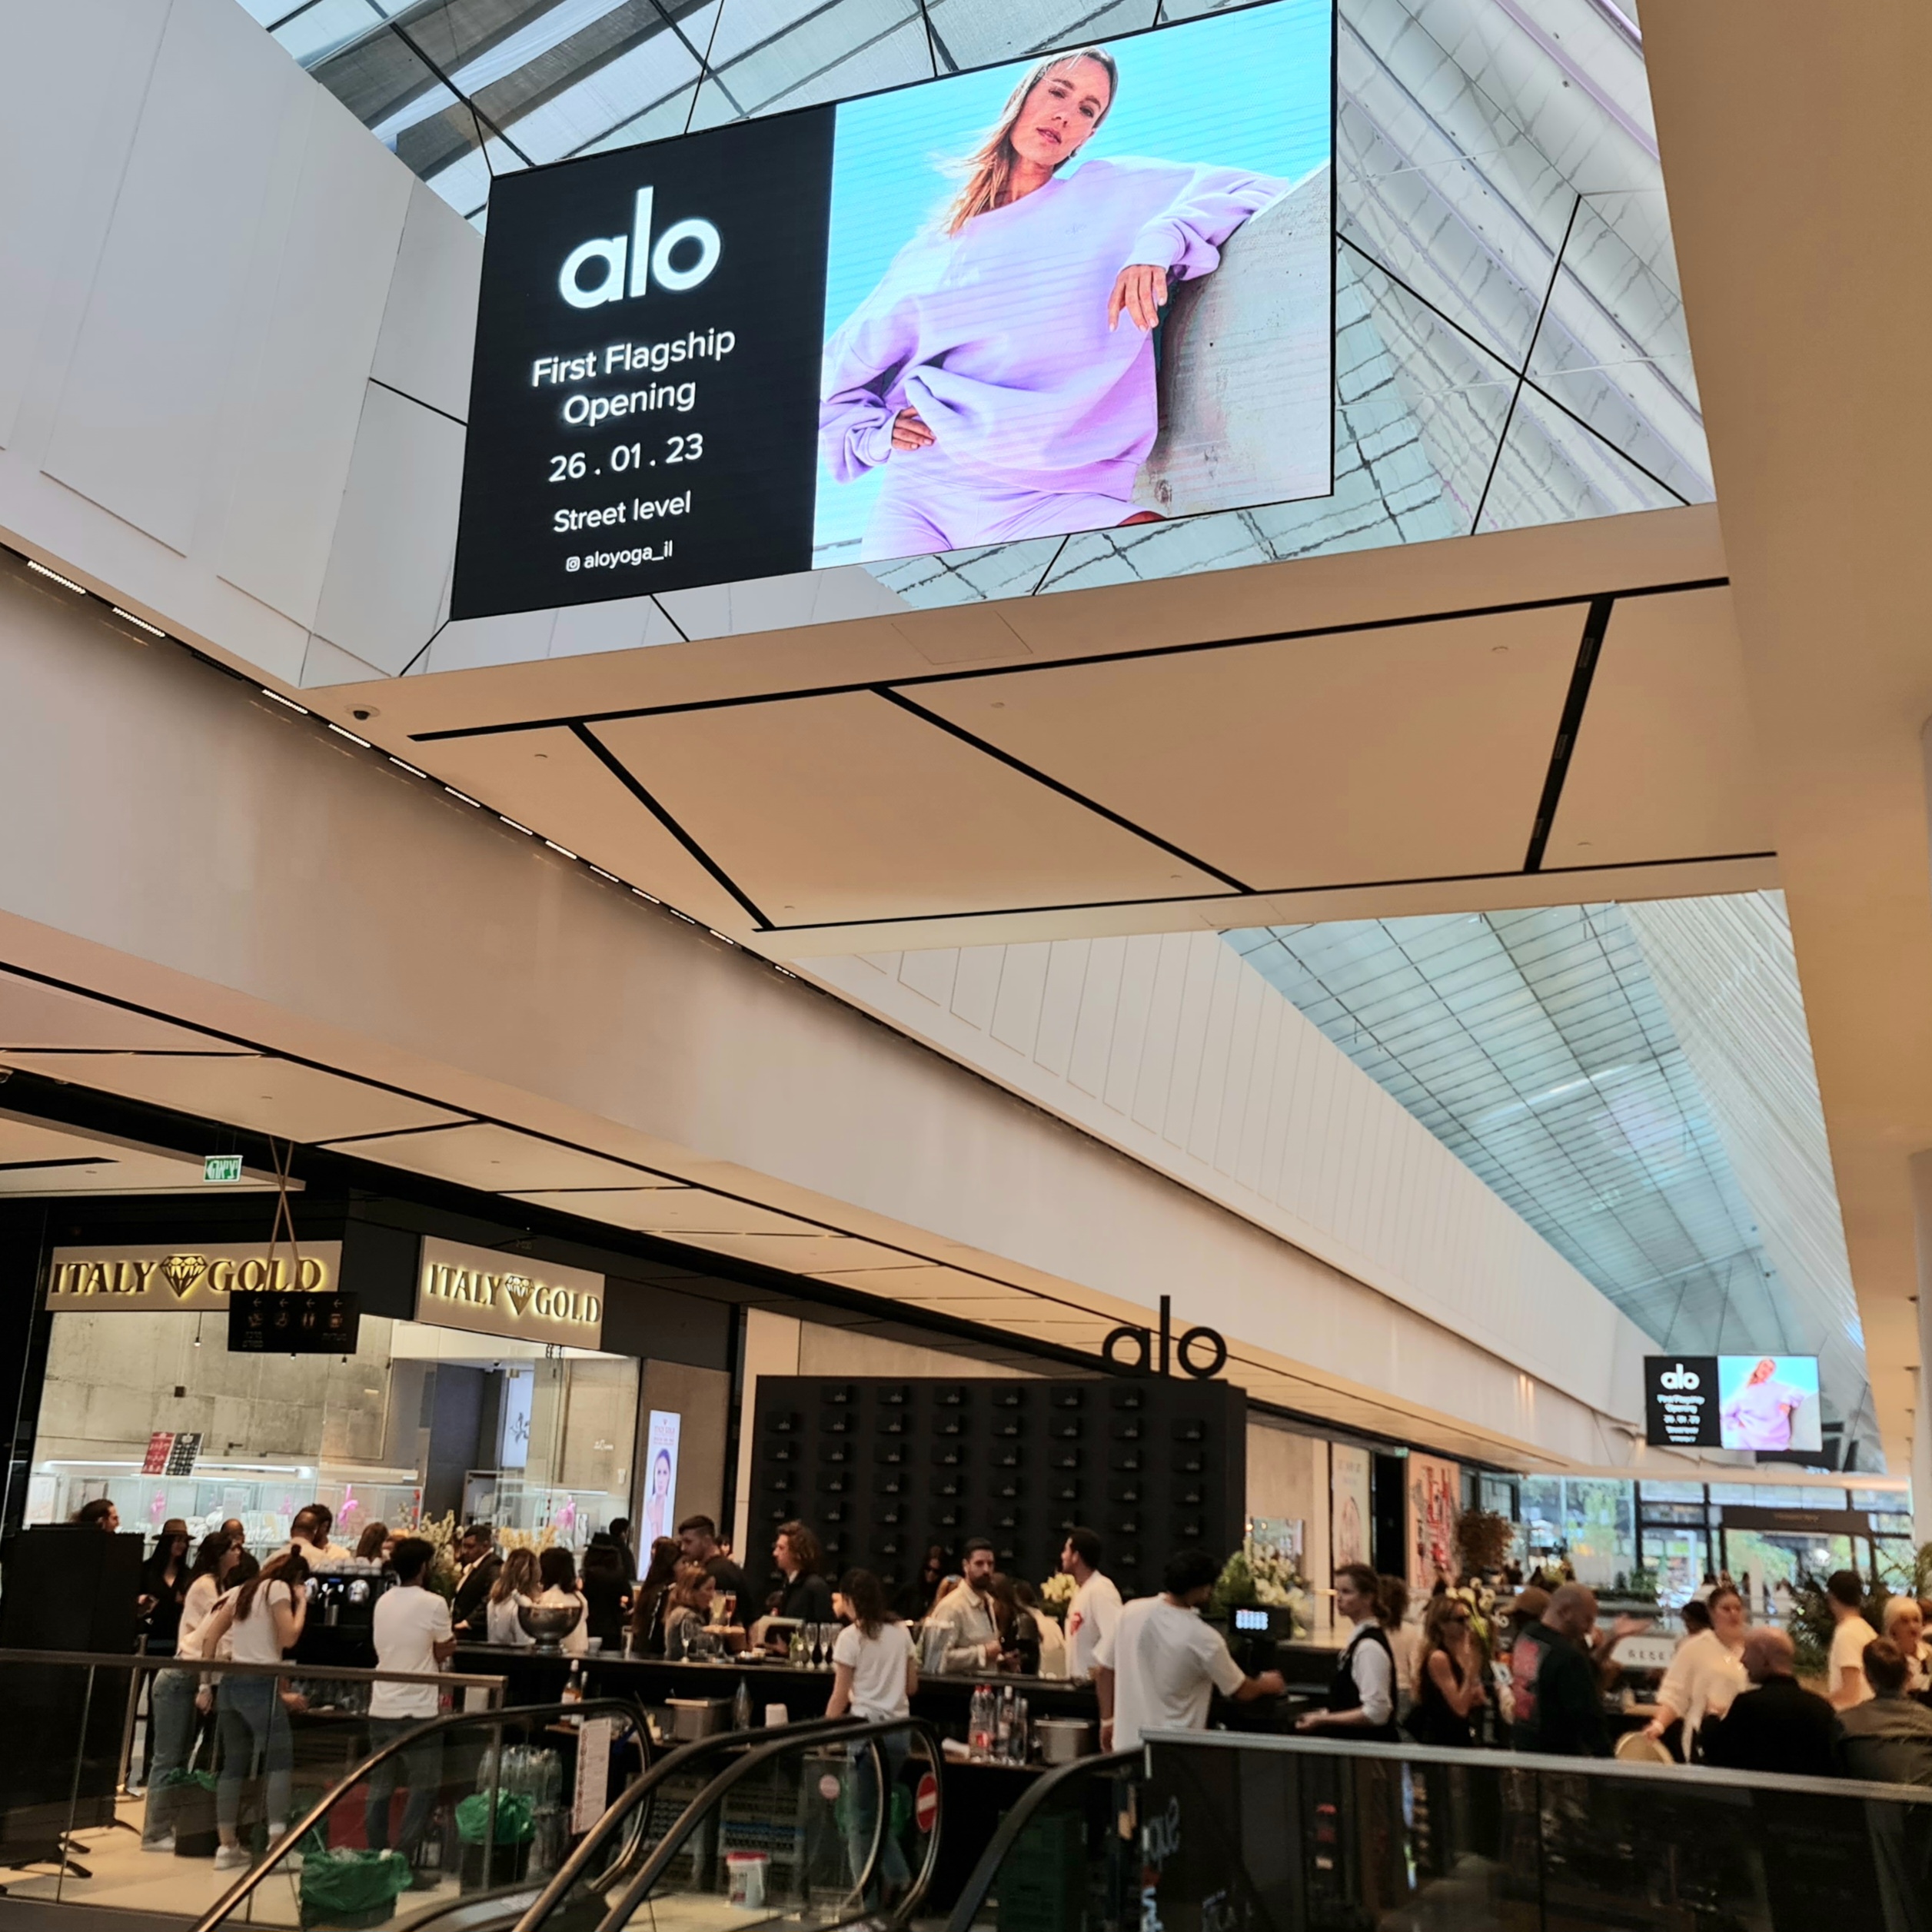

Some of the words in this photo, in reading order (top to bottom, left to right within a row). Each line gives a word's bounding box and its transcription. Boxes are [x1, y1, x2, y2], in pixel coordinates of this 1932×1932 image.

[557, 185, 722, 310] alo
[532, 351, 597, 387] First
[604, 328, 736, 375] Flagship
[562, 381, 697, 427] Opening
[553, 501, 627, 533] Street
[633, 490, 691, 521] level
[52, 1261, 156, 1293] ITALY
[208, 1259, 321, 1292] GOLD
[430, 1264, 502, 1306] ITALY
[535, 1287, 601, 1323] GOLD
[1102, 1295, 1227, 1378] alo
[1660, 1362, 1701, 1391] alo
